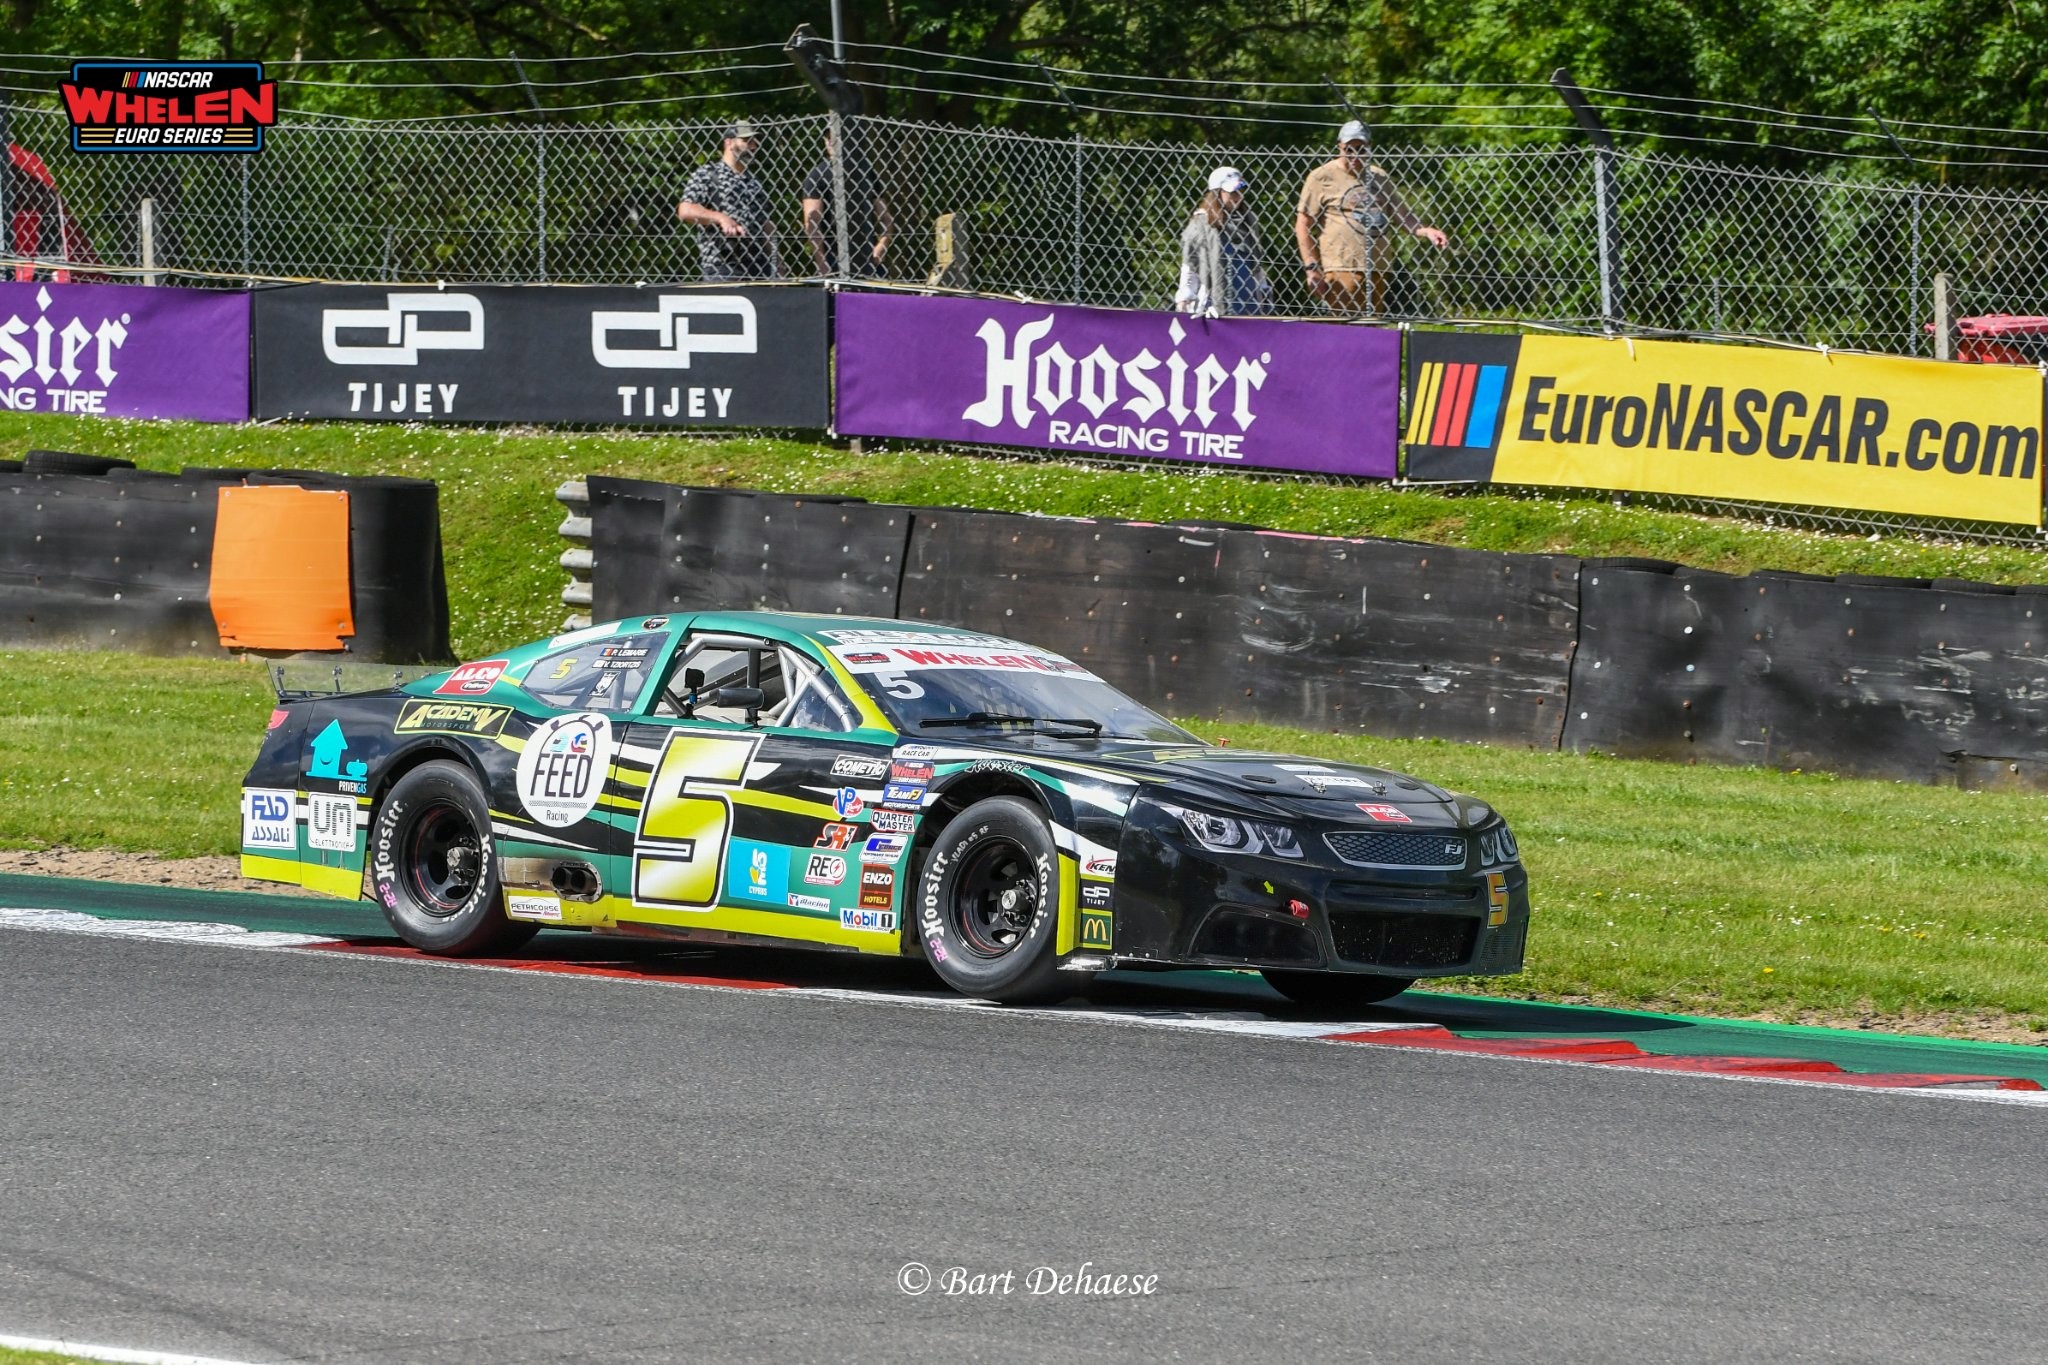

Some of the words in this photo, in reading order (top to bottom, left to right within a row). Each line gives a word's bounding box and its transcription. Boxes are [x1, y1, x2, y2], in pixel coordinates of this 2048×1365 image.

[961, 312, 1268, 432] Hoosier
[46, 388, 108, 414] TIRE
[347, 382, 459, 414] TIJEY
[617, 386, 732, 418] TIJEY
[1518, 375, 2039, 480] EuroNASCAR.com
[1048, 420, 1169, 453] RACING
[1179, 430, 1245, 460] TIRE
[549, 658, 579, 680] 5
[891, 648, 1050, 671] WHELEN
[451, 667, 501, 680] ALCO
[873, 670, 926, 700] 5
[530, 753, 593, 799] FEED
[891, 764, 934, 779] WHELEN
[837, 787, 857, 815] VP
[546, 809, 569, 824] Racing
[634, 728, 764, 911] 5
[872, 811, 913, 823] QUARTER
[878, 821, 913, 832] MASTER
[1444, 843, 1463, 855] FJ
[863, 872, 893, 886] ENZO
[864, 896, 888, 905] HOTELS
[1484, 870, 1510, 929] 5
[843, 909, 877, 926] Mobil
